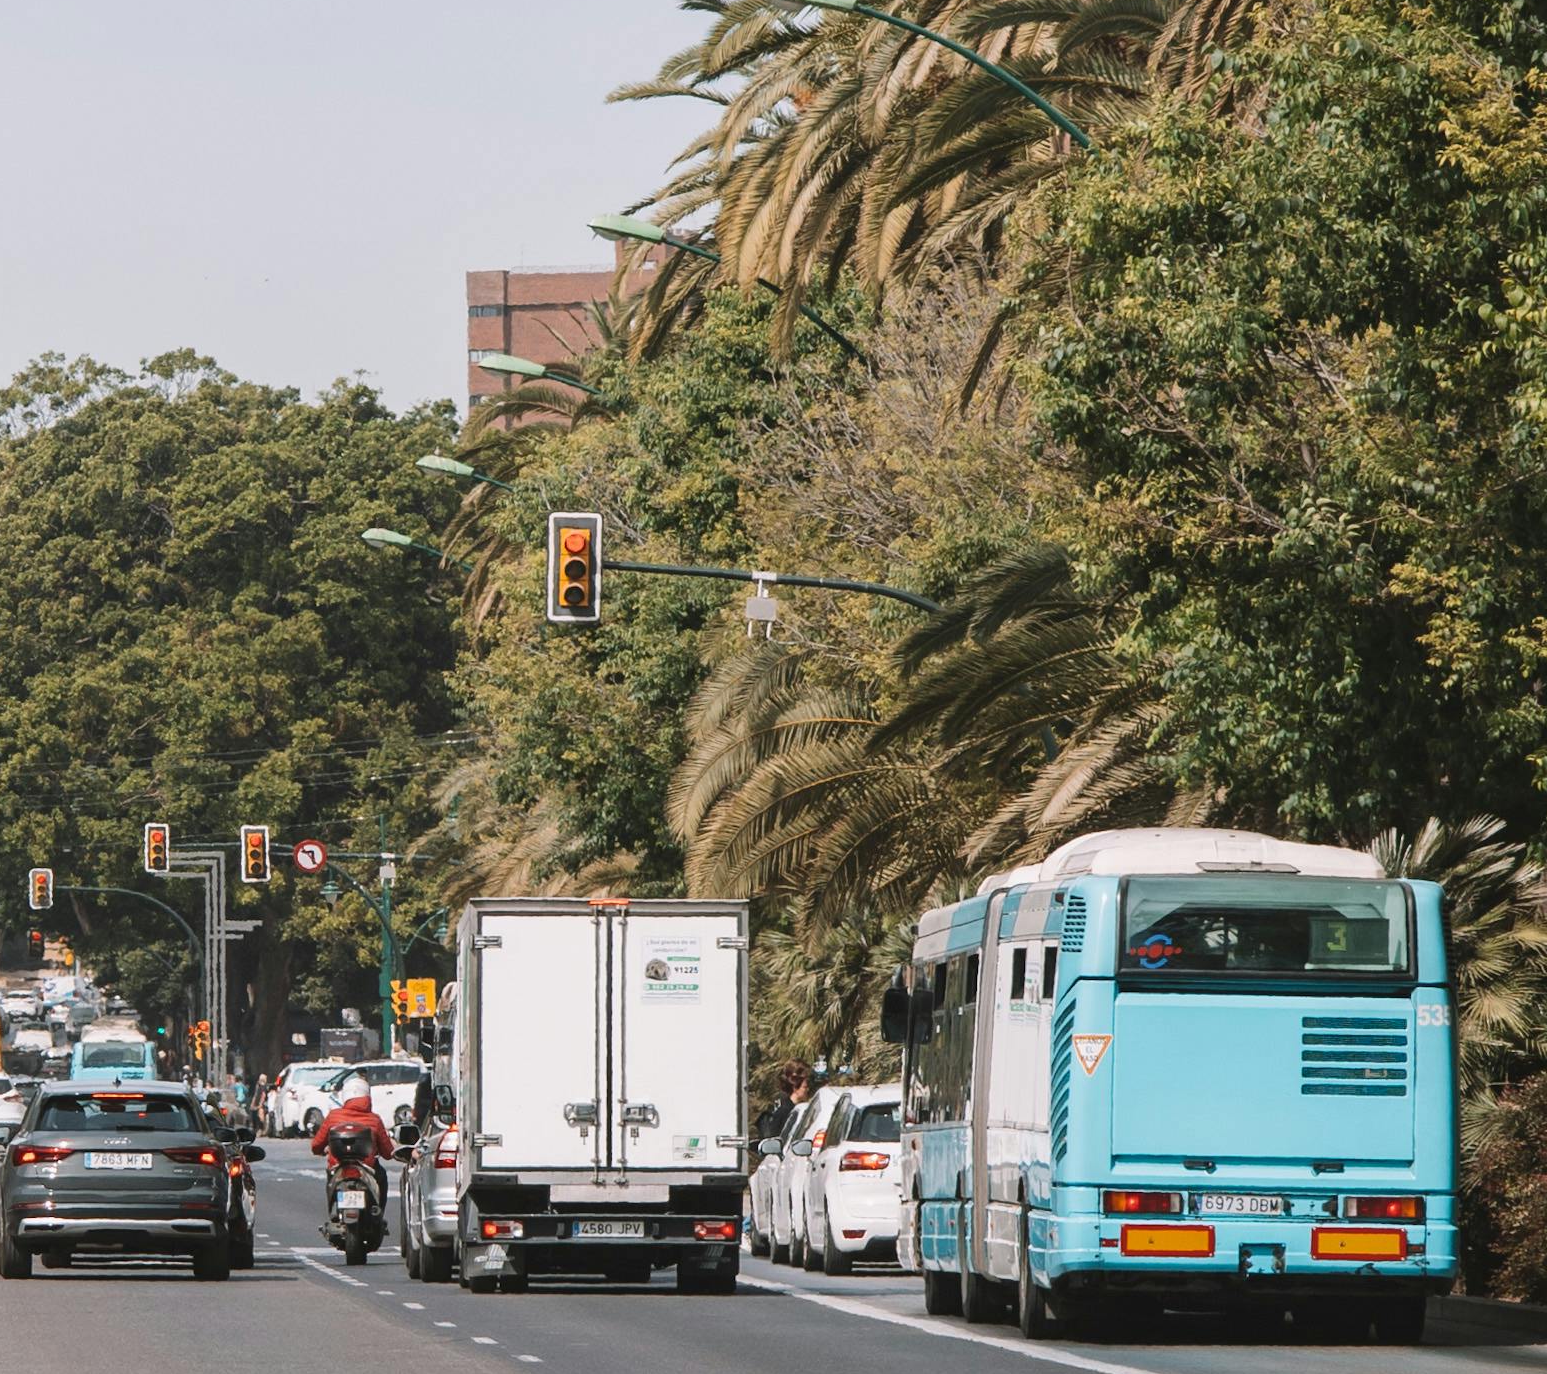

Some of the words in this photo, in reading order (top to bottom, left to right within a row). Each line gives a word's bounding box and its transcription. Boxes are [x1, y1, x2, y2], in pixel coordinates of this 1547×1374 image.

[1326, 922, 1347, 952] 3
[1205, 1195, 1245, 1212] 6973
[581, 1223, 613, 1235] 4580
[618, 1223, 641, 1235] JPV
